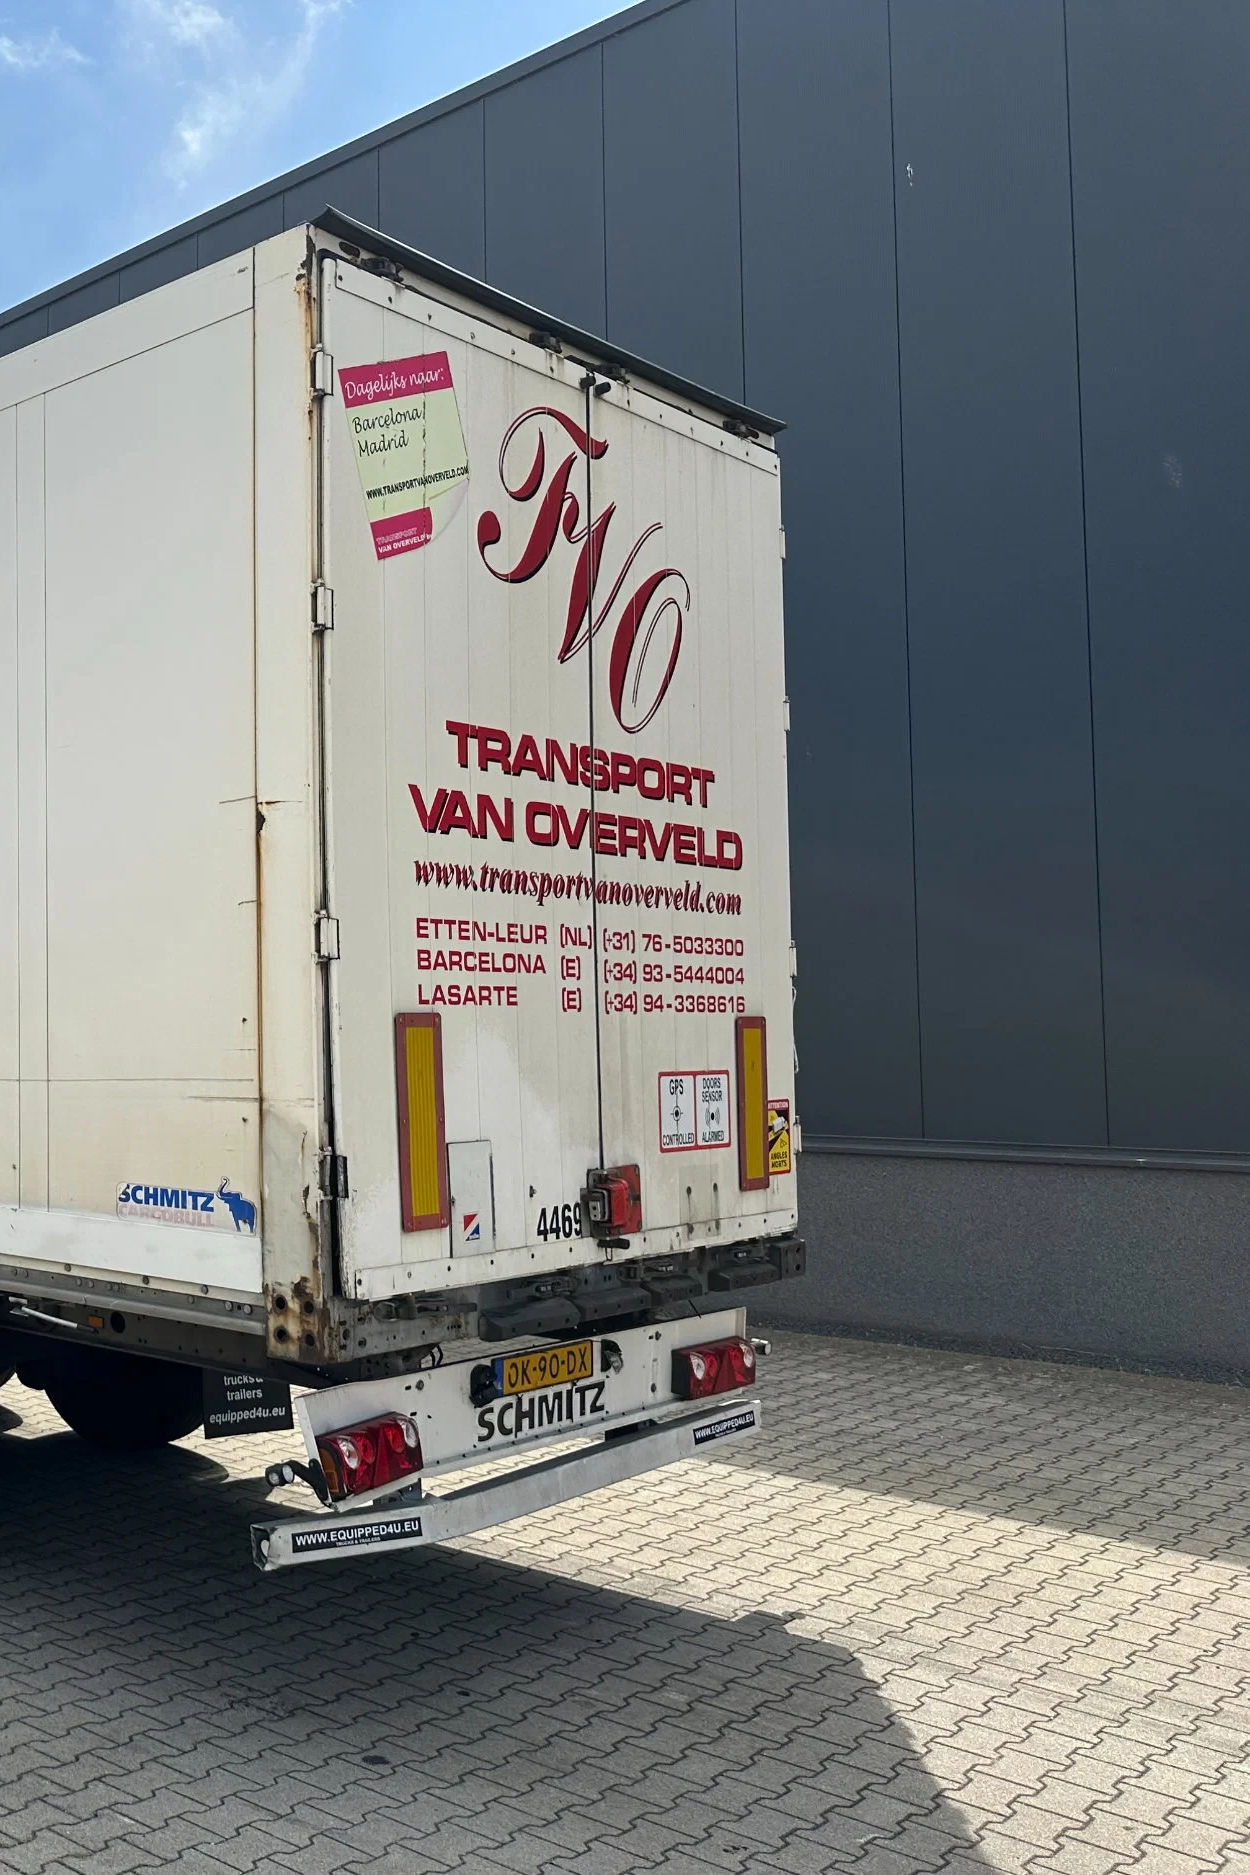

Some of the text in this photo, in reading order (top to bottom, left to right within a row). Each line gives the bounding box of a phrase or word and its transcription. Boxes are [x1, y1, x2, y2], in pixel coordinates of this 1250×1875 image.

[345, 368, 444, 400] Dagelijks naar:
[352, 408, 422, 434] Barcelona
[358, 430, 409, 457] Madrid
[366, 466, 469, 500] WWW.TRANSPORTVANOVERVELD.COM
[378, 544, 392, 553] VAN
[393, 534, 425, 550] OVERVELD
[446, 720, 714, 809] TRANSPORT
[408, 783, 743, 870] VAN OVERVELD
[414, 860, 742, 916] www.transportvanoverveld.com
[416, 918, 548, 945] ETTEN-LEUR
[560, 923, 592, 950] (NL)
[603, 928, 636, 954] (+31)
[417, 949, 546, 974] BARCELONA
[561, 955, 581, 981] (E)
[604, 959, 637, 985] (+34)
[418, 984, 518, 1006] LASARTE
[562, 987, 582, 1012] (E)
[604, 990, 638, 1015] (+34)
[669, 1079, 684, 1095] GPS
[701, 1090, 723, 1102] SENSOR
[702, 1077, 721, 1089] DOORS
[662, 1132, 695, 1146] CONTROLLED
[701, 1130, 725, 1142] ALARMED
[770, 1151, 788, 1160] ANGLES
[771, 1160, 788, 1169] MORTS
[118, 1183, 215, 1213] SCHMITZ
[508, 1347, 588, 1388] OK-90-DX
[227, 1388, 263, 1401] trailers
[210, 1406, 286, 1425] equipped4u.eu
[477, 1380, 605, 1442] SCHMITZ
[295, 1520, 419, 1546] WWW.EQUIPPED4U.EU
